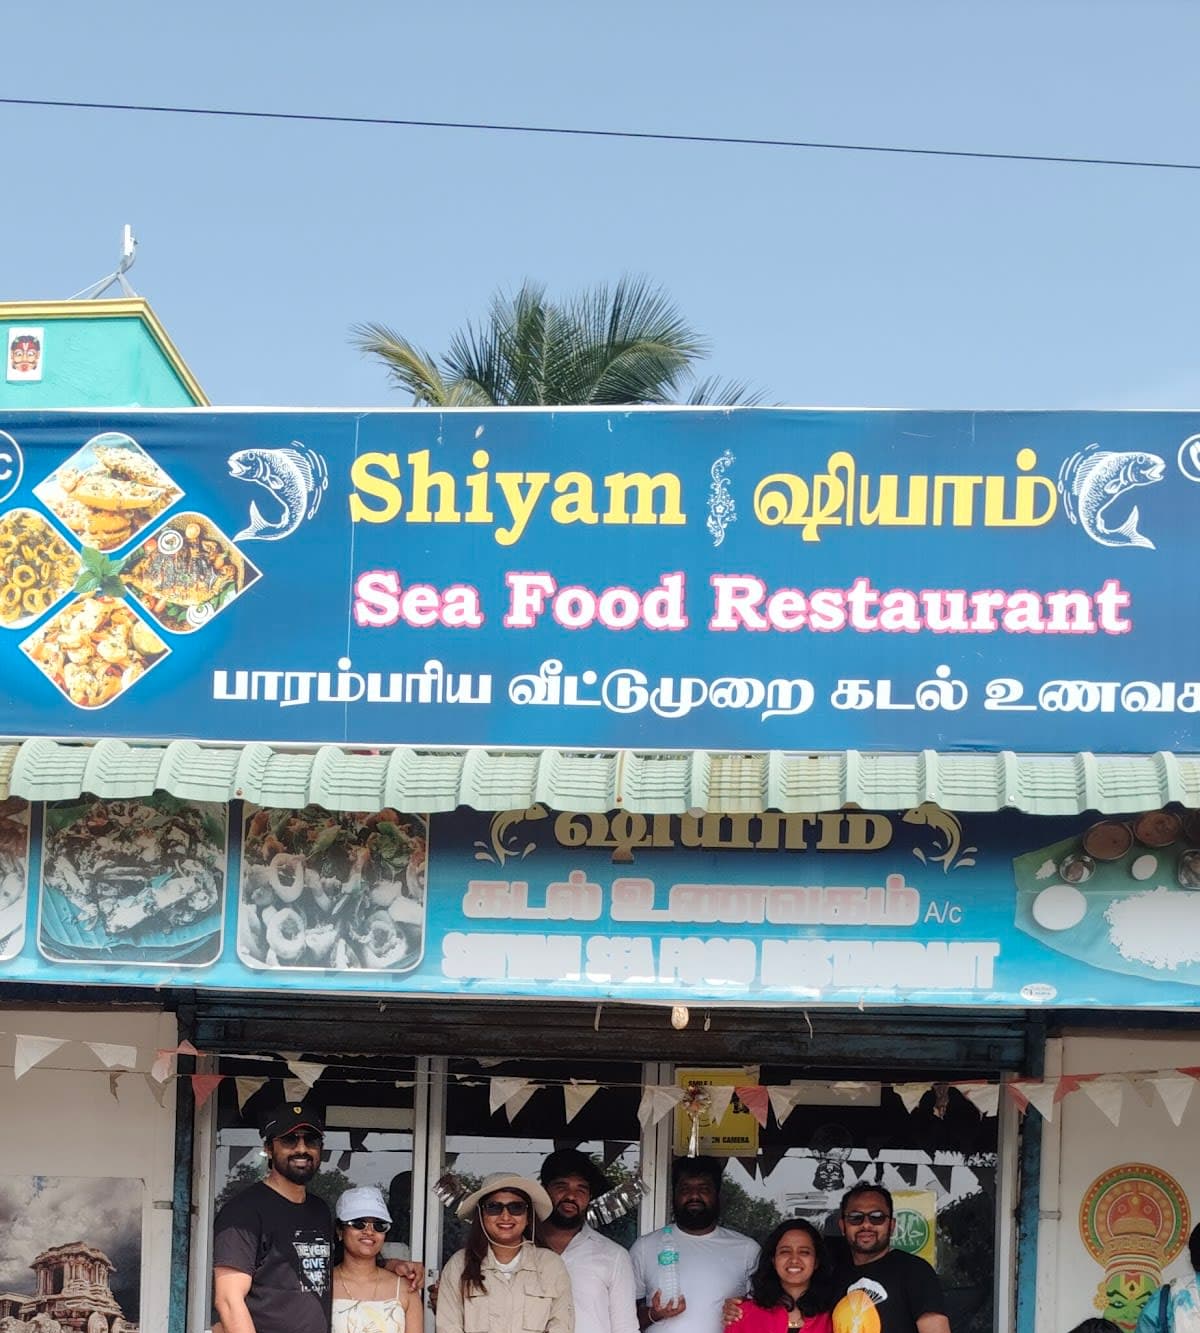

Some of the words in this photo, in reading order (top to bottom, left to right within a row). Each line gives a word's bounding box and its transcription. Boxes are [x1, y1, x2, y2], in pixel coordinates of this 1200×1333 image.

[349, 450, 687, 546] Shiyam
[754, 447, 1058, 542] ஷியாம்
[353, 570, 485, 628] Sea
[503, 571, 689, 631] Food
[708, 574, 1133, 635] Restaurant
[213, 657, 492, 707] பாரம்பரிய
[508, 659, 815, 721] வீட்டுமுறை
[830, 664, 968, 711] கடல்
[463, 870, 603, 921] கடல்
[611, 873, 920, 926] உணவகம்
[924, 901, 962, 924] A/c
[722, 1136, 750, 1144] CAMERA
[302, 1257, 326, 1270] GIVE
